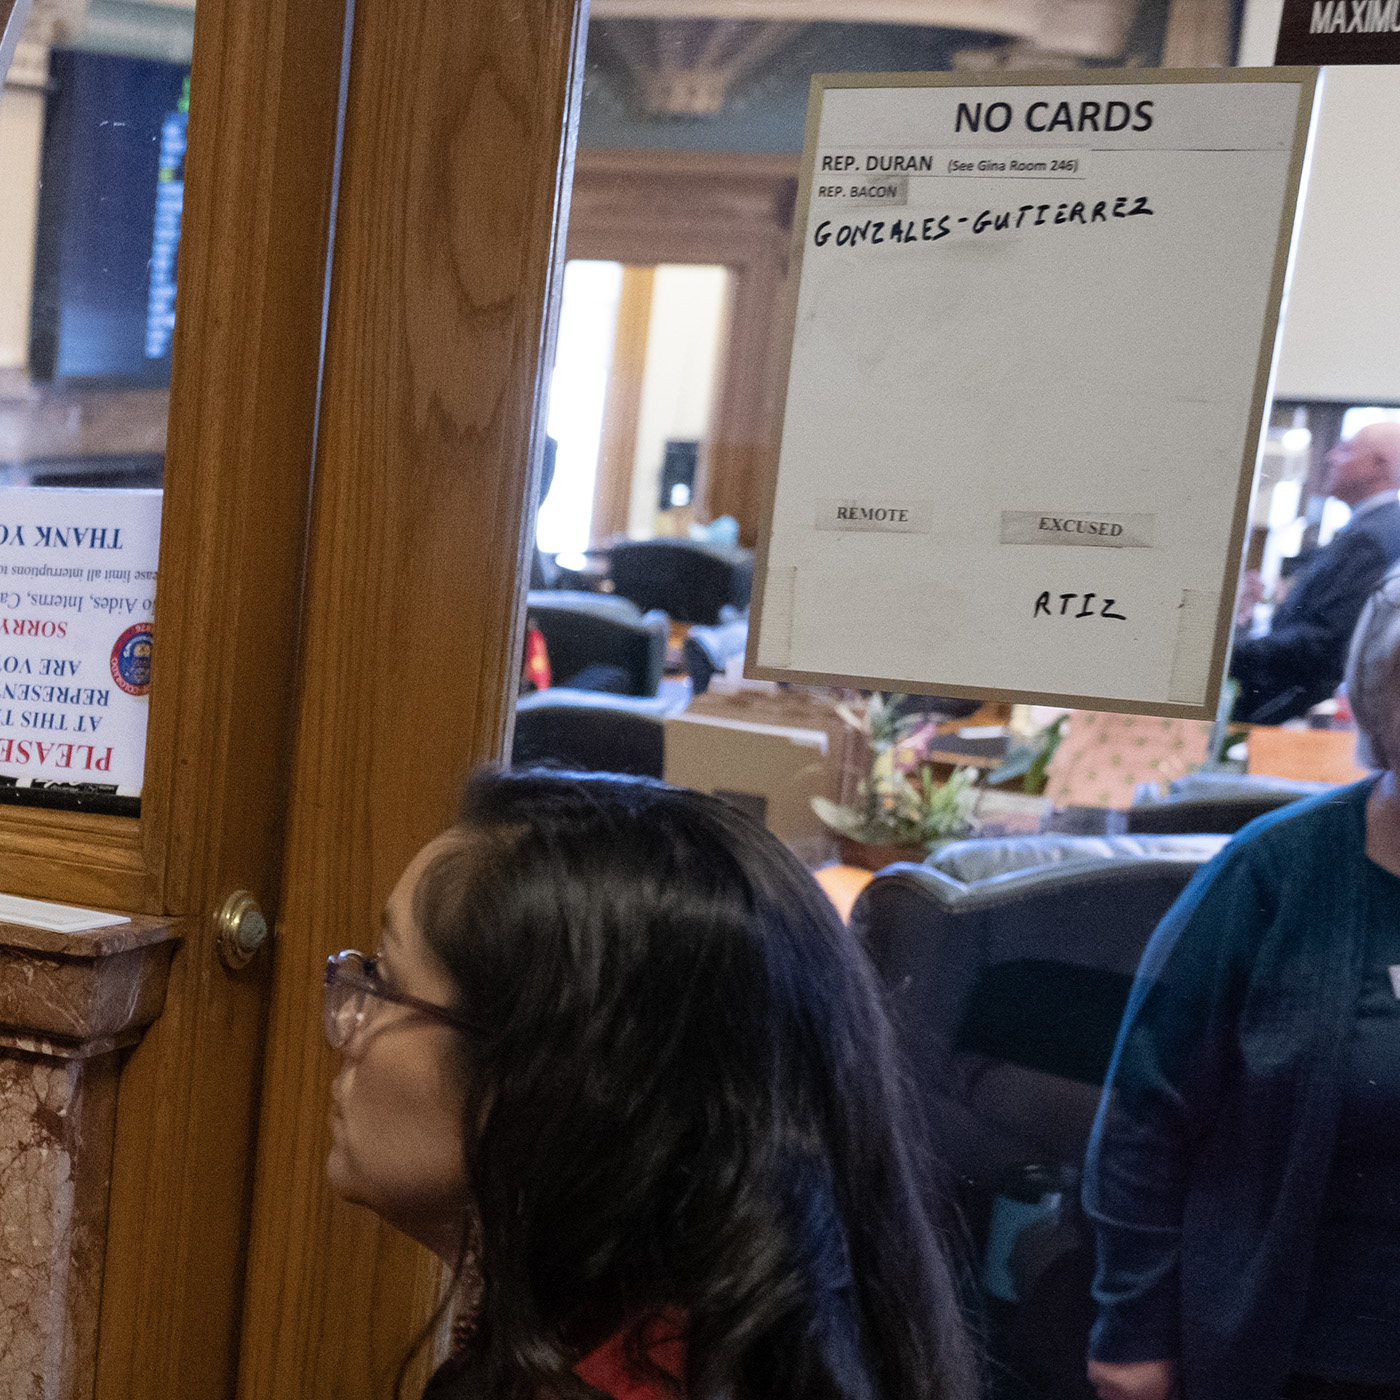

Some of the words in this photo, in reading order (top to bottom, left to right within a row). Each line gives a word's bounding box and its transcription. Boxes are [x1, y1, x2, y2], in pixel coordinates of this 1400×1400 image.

[953, 101, 1013, 135] NO
[1024, 99, 1155, 134] CARDS
[821, 155, 860, 171] REP.
[866, 155, 934, 171] DURAN
[947, 159, 974, 174] (See
[977, 159, 1006, 173] Gina
[1009, 160, 1047, 173] Room
[1049, 159, 1079, 174] 246)
[818, 186, 846, 198] REP.
[850, 185, 898, 198] BACON
[814, 196, 1154, 247] GONZALES-GUTIERREZ
[836, 506, 910, 523] REMOTE
[1038, 517, 1123, 537] EXCUSED
[34, 525, 123, 549] THANK
[12, 565, 83, 580] interruptions
[83, 568, 101, 581] all
[104, 570, 131, 583] limit
[27, 590, 83, 612] Interns,
[89, 593, 137, 615] Aides,
[1033, 591, 1128, 621] RTIZ
[38, 658, 82, 677] ARE
[20, 711, 69, 731] THIS
[72, 714, 103, 732] AT
